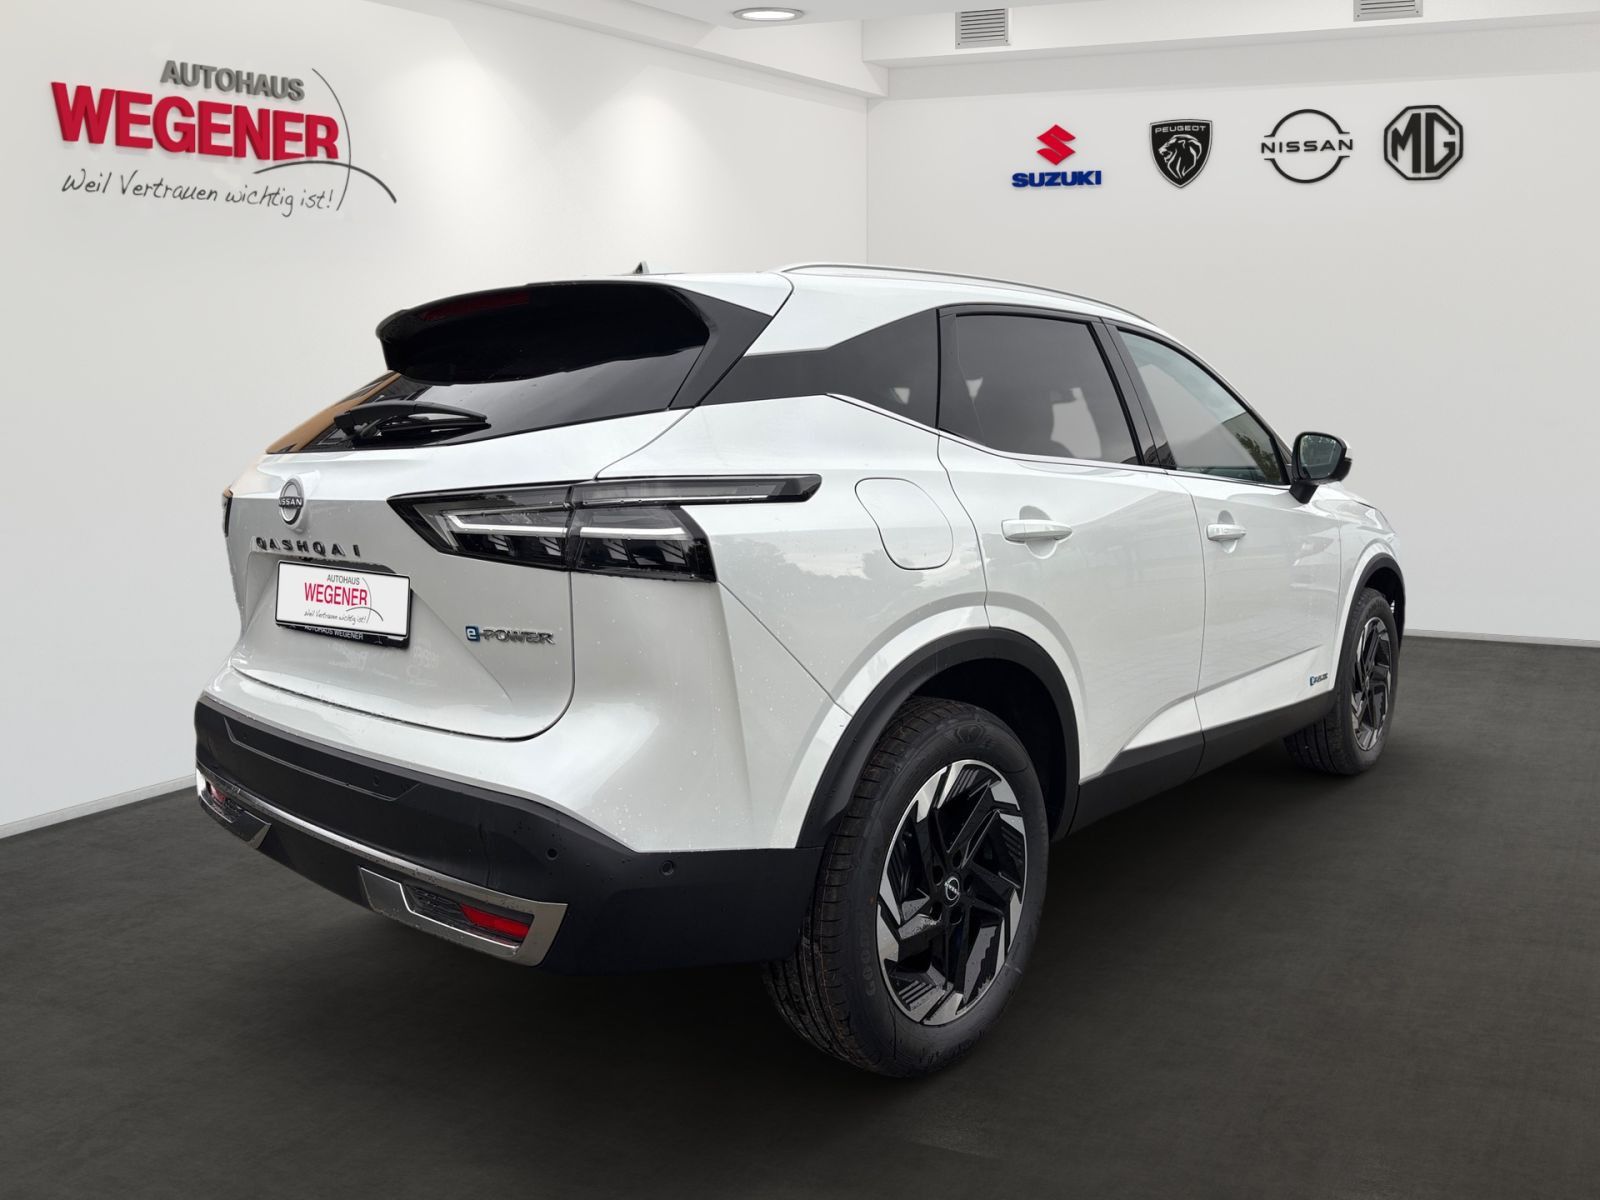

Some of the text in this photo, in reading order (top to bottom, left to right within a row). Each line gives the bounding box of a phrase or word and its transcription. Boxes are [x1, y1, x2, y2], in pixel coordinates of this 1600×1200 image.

[160, 60, 305, 101] AUTOHAUS
[51, 82, 340, 161] WEGENER
[1154, 125, 1207, 134] PEUGEOT
[1260, 138, 1354, 154] NISSAN
[1391, 112, 1456, 174] MG
[1012, 170, 1102, 188] SUZUKI
[61, 168, 334, 218] Weil Vertrauen wichtig ist!
[255, 536, 361, 557] QASHQAI
[326, 574, 361, 586] AUTOHAUS
[304, 582, 368, 606] WEGENER
